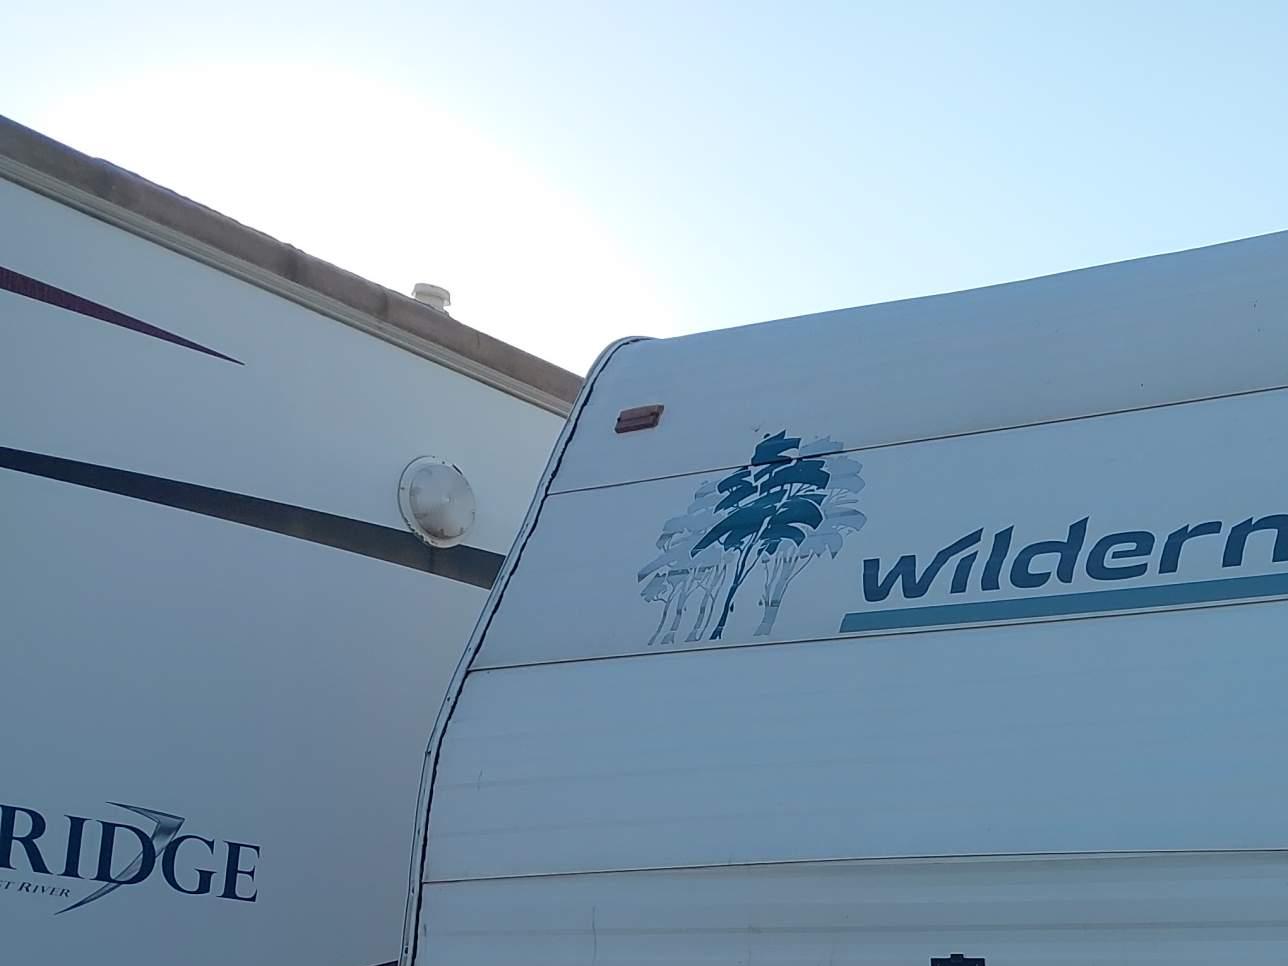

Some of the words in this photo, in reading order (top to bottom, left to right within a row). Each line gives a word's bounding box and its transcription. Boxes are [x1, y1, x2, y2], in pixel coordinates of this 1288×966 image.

[0, 804, 261, 903] RIDGE
[0, 880, 15, 890] T
[17, 881, 71, 898] RIVER
